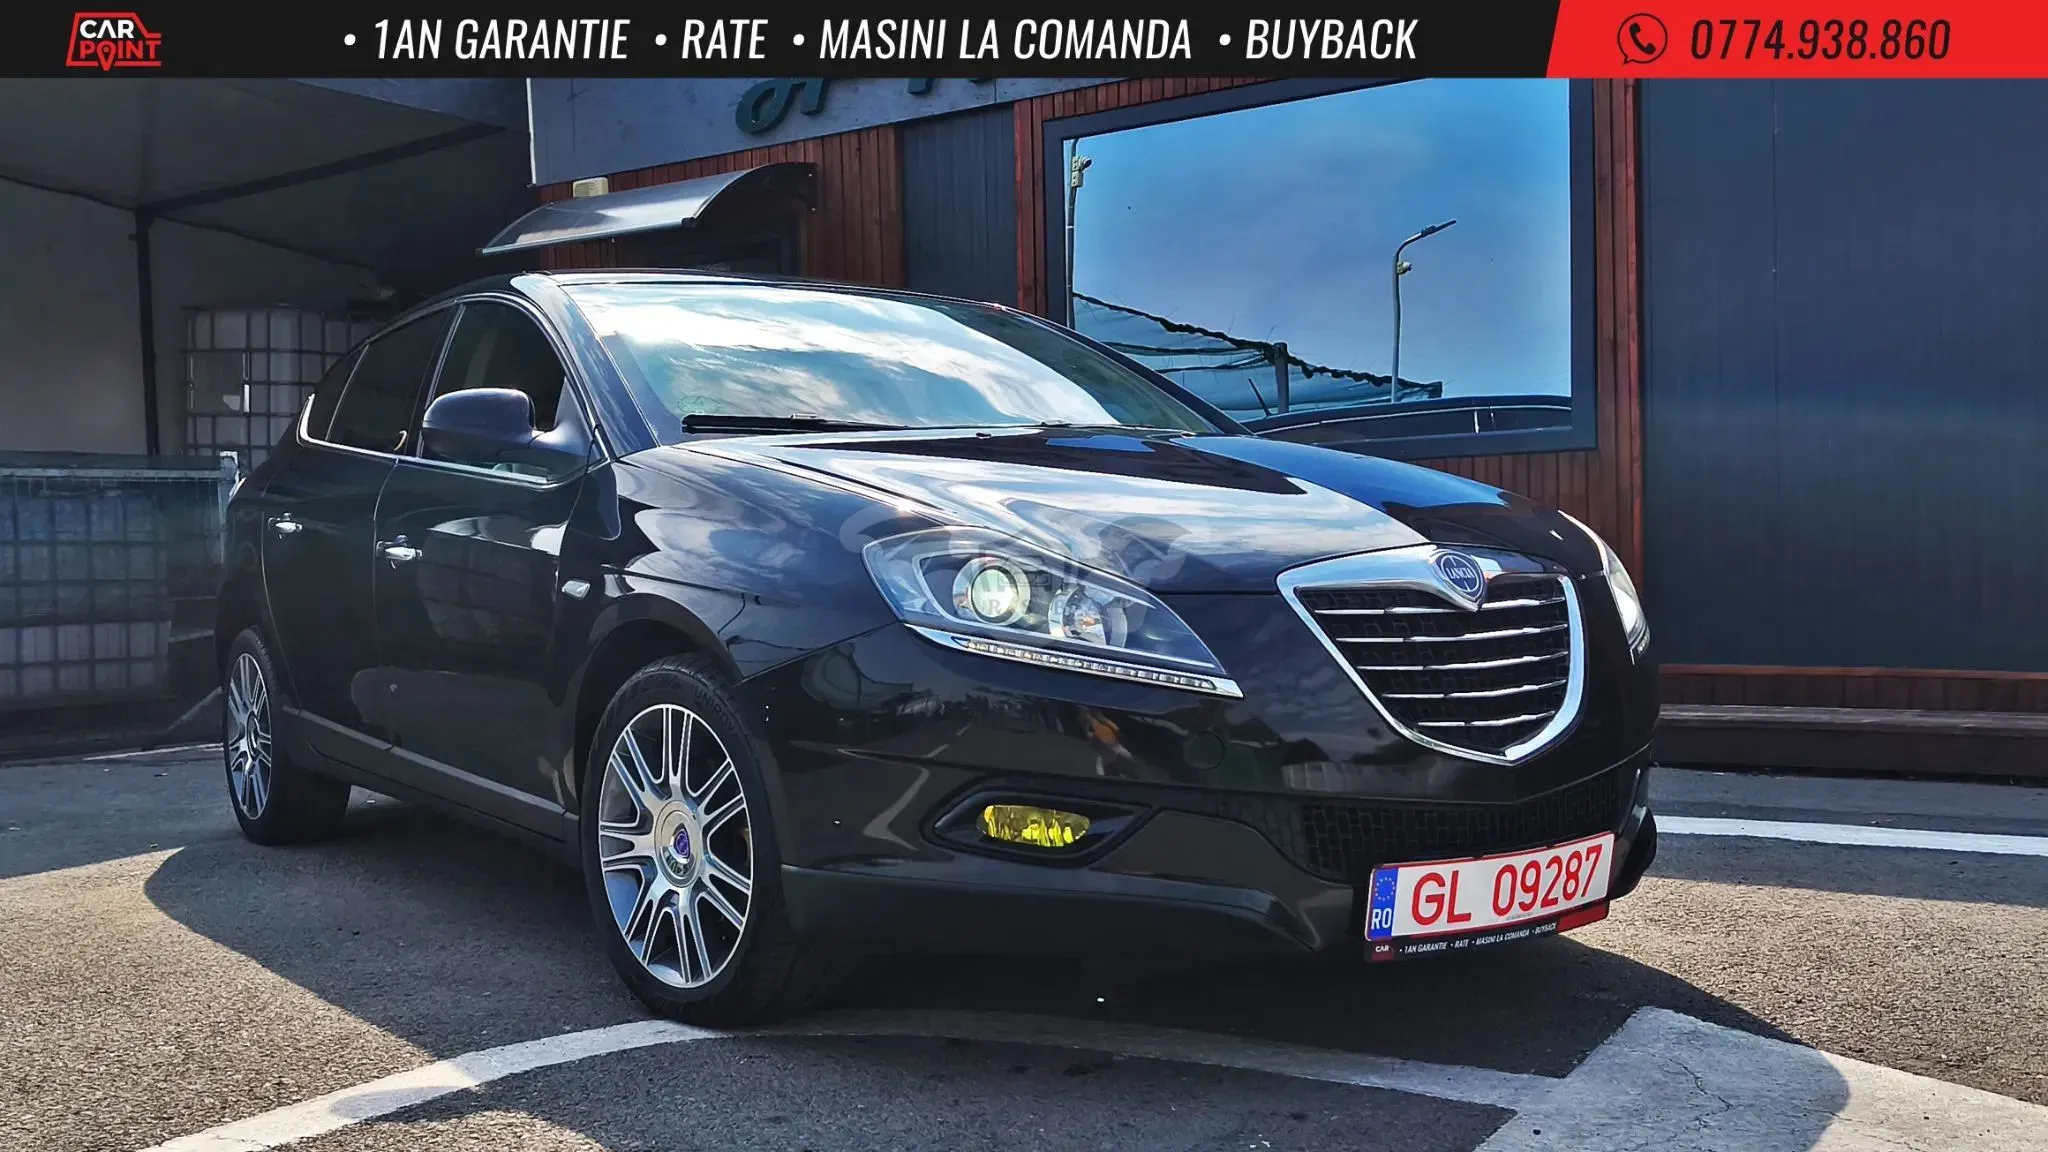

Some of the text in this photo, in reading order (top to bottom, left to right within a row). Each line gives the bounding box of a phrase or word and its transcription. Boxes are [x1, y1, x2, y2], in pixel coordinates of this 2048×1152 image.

[1411, 843, 1603, 926] GL 09287
[1371, 907, 1393, 931] RO
[1417, 941, 1449, 953] GARANTIE
[1454, 938, 1470, 949] RATE
